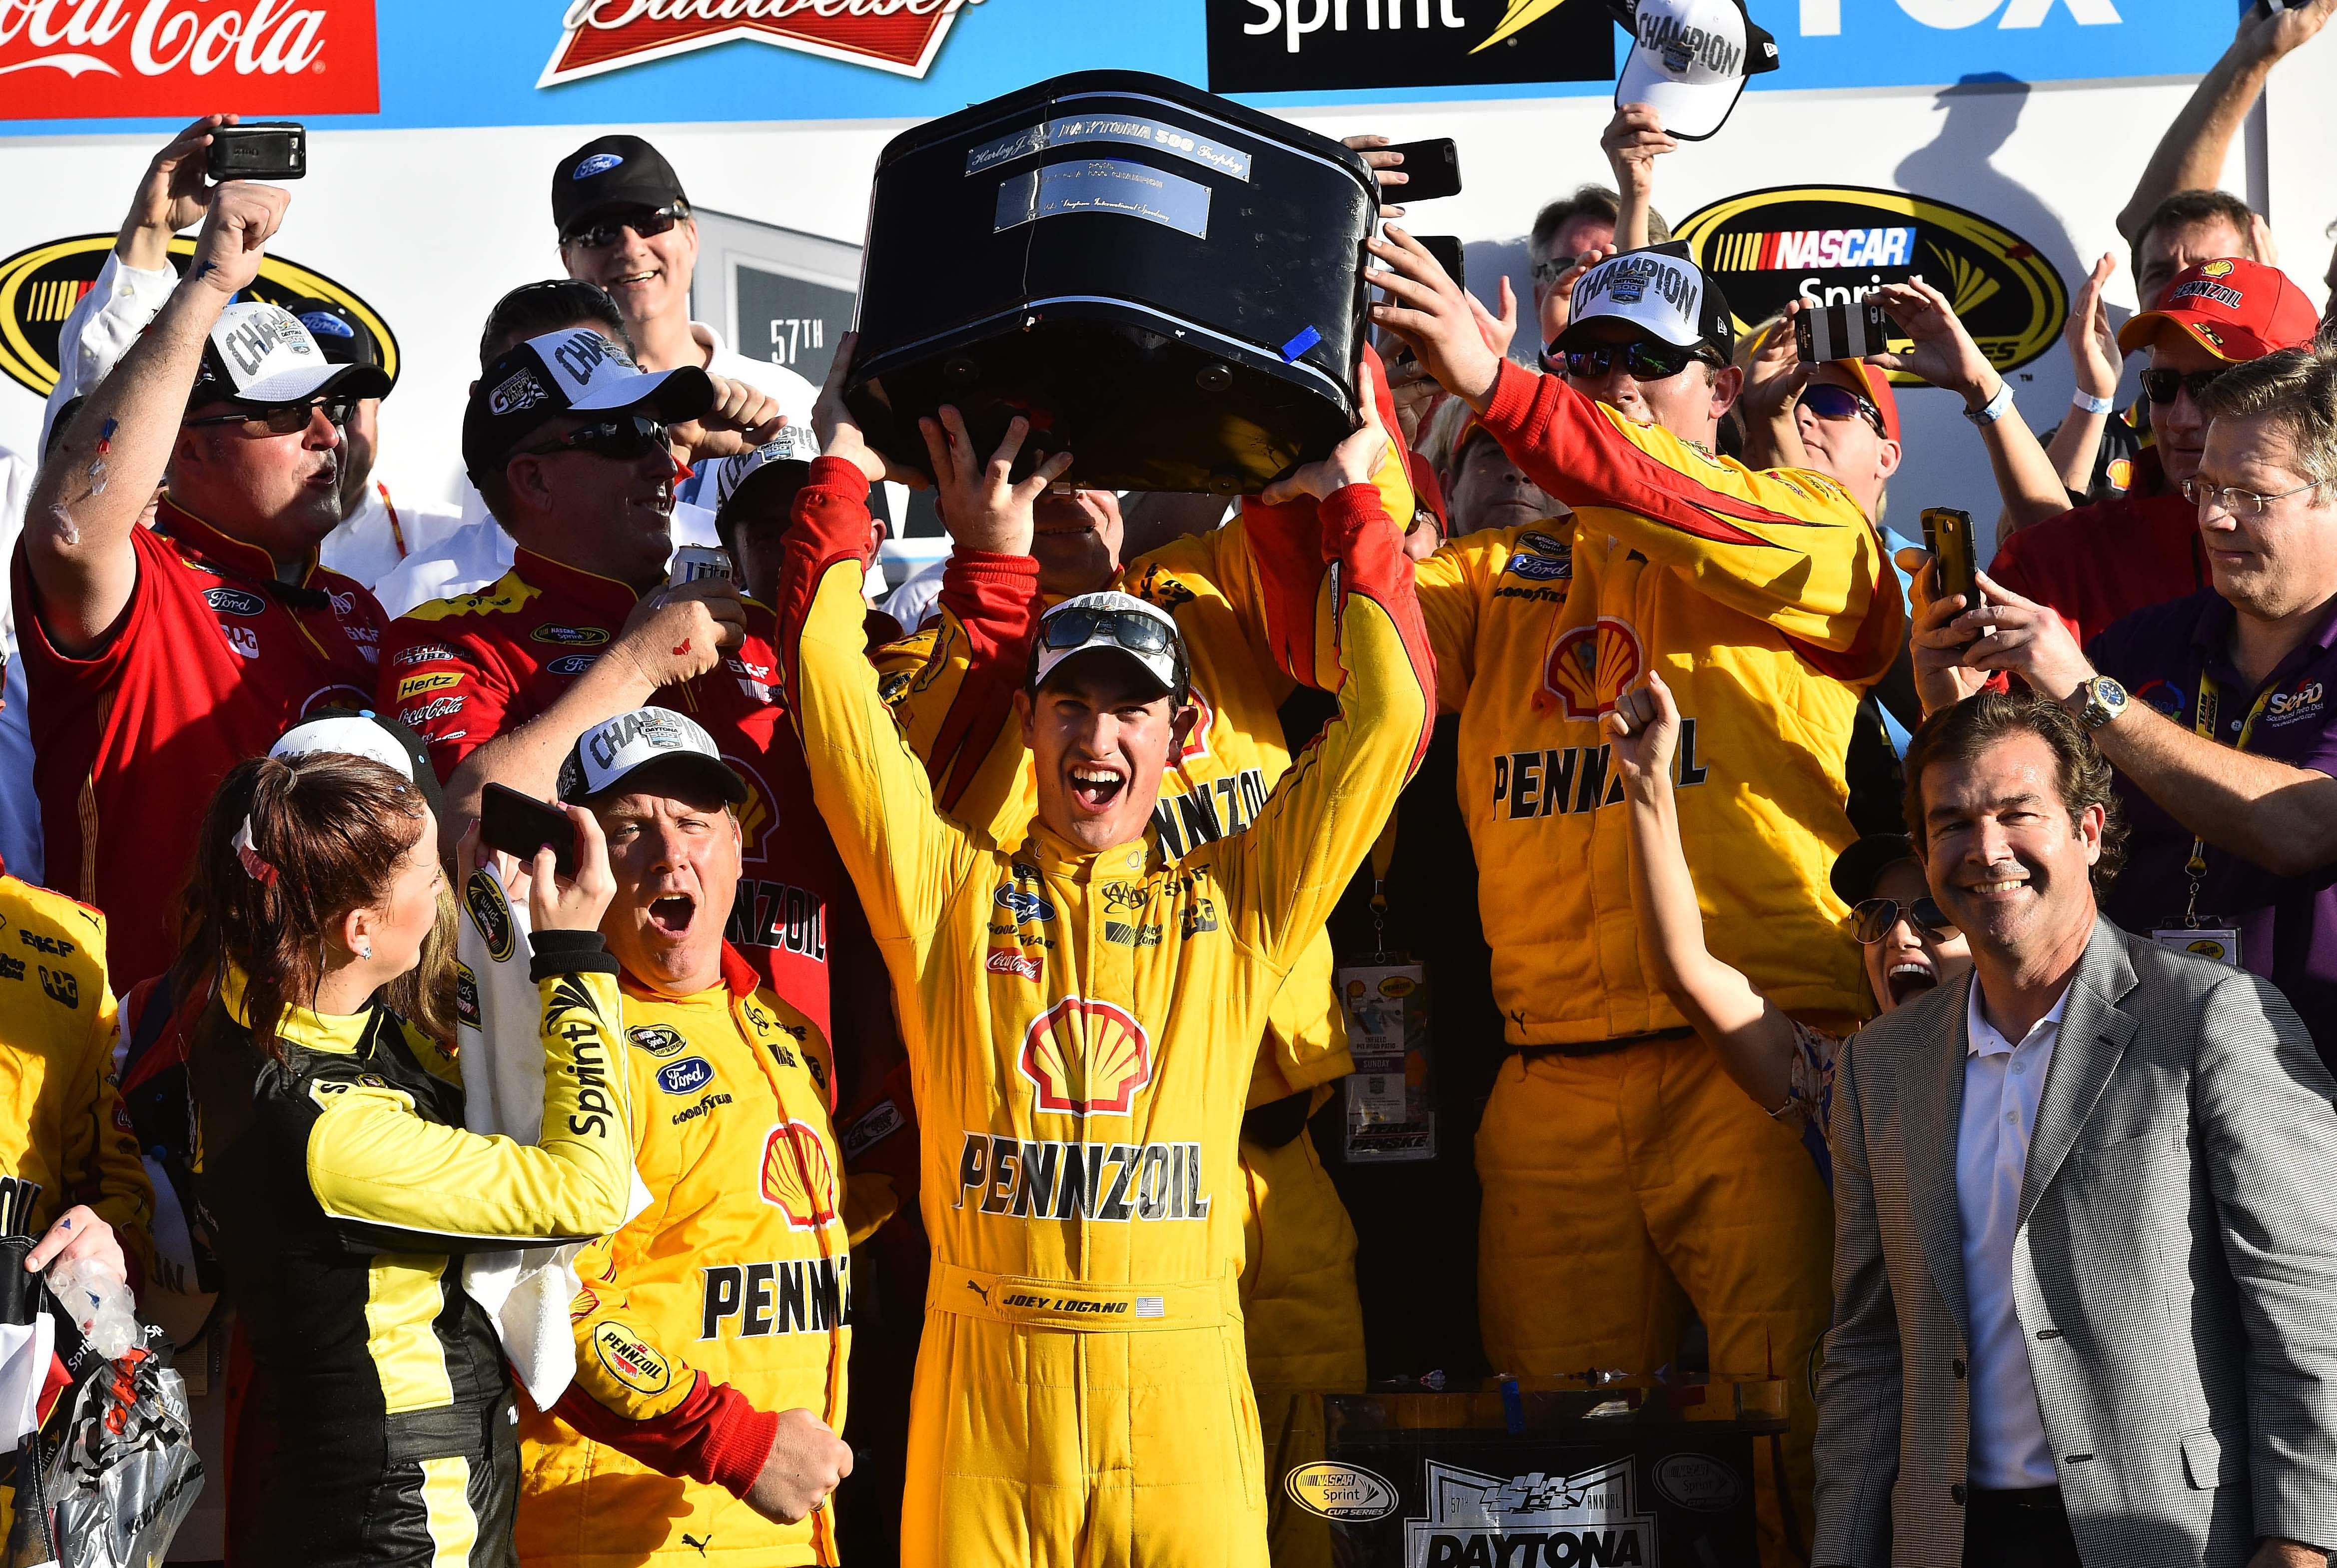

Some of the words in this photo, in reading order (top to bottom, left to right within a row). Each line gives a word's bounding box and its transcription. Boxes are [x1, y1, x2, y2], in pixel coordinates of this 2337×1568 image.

[1639, 13, 1740, 77] CHAMPION
[1154, 128, 1195, 153] 500
[1196, 144, 1245, 174] Trophy
[580, 156, 613, 175] Ford
[1094, 197, 1138, 211] International
[1137, 204, 1171, 222] Speedway
[1775, 227, 1908, 269] NASCAR
[1574, 257, 1698, 325] CHAMPION
[2169, 280, 2244, 310] PENNZOIL
[503, 375, 530, 397] VICTORY
[507, 389, 525, 404] LANE
[761, 439, 791, 450] DAYTONA
[1516, 558, 1566, 575] Ford
[208, 590, 251, 612] Ford
[726, 658, 770, 679] SKF
[401, 674, 453, 696] Hertz
[2199, 692, 2207, 725] TEAM
[2207, 691, 2218, 734] PENSKE
[2311, 702, 2324, 711] Dist
[480, 895, 500, 928] Sprint
[492, 895, 507, 913] CUP
[19, 929, 75, 958] SKF
[41, 969, 76, 997] PPG
[647, 1035, 666, 1048] Sprint
[571, 1023, 614, 1139] Sprint
[667, 1063, 705, 1091] Ford
[672, 1092, 733, 1125] GOODYEAR
[951, 1129, 1212, 1223] PENNZOIL
[1003, 1294, 1051, 1309] JOEY
[1053, 1298, 1128, 1315] LOGANO
[602, 1332, 663, 1380] PENNZOIL
[1316, 1474, 1354, 1487] NASCAR
[1323, 1488, 1360, 1503] Sprint
[1587, 1493, 1620, 1510] ANNUAL
[1427, 1529, 1642, 1568] DAYTONA
